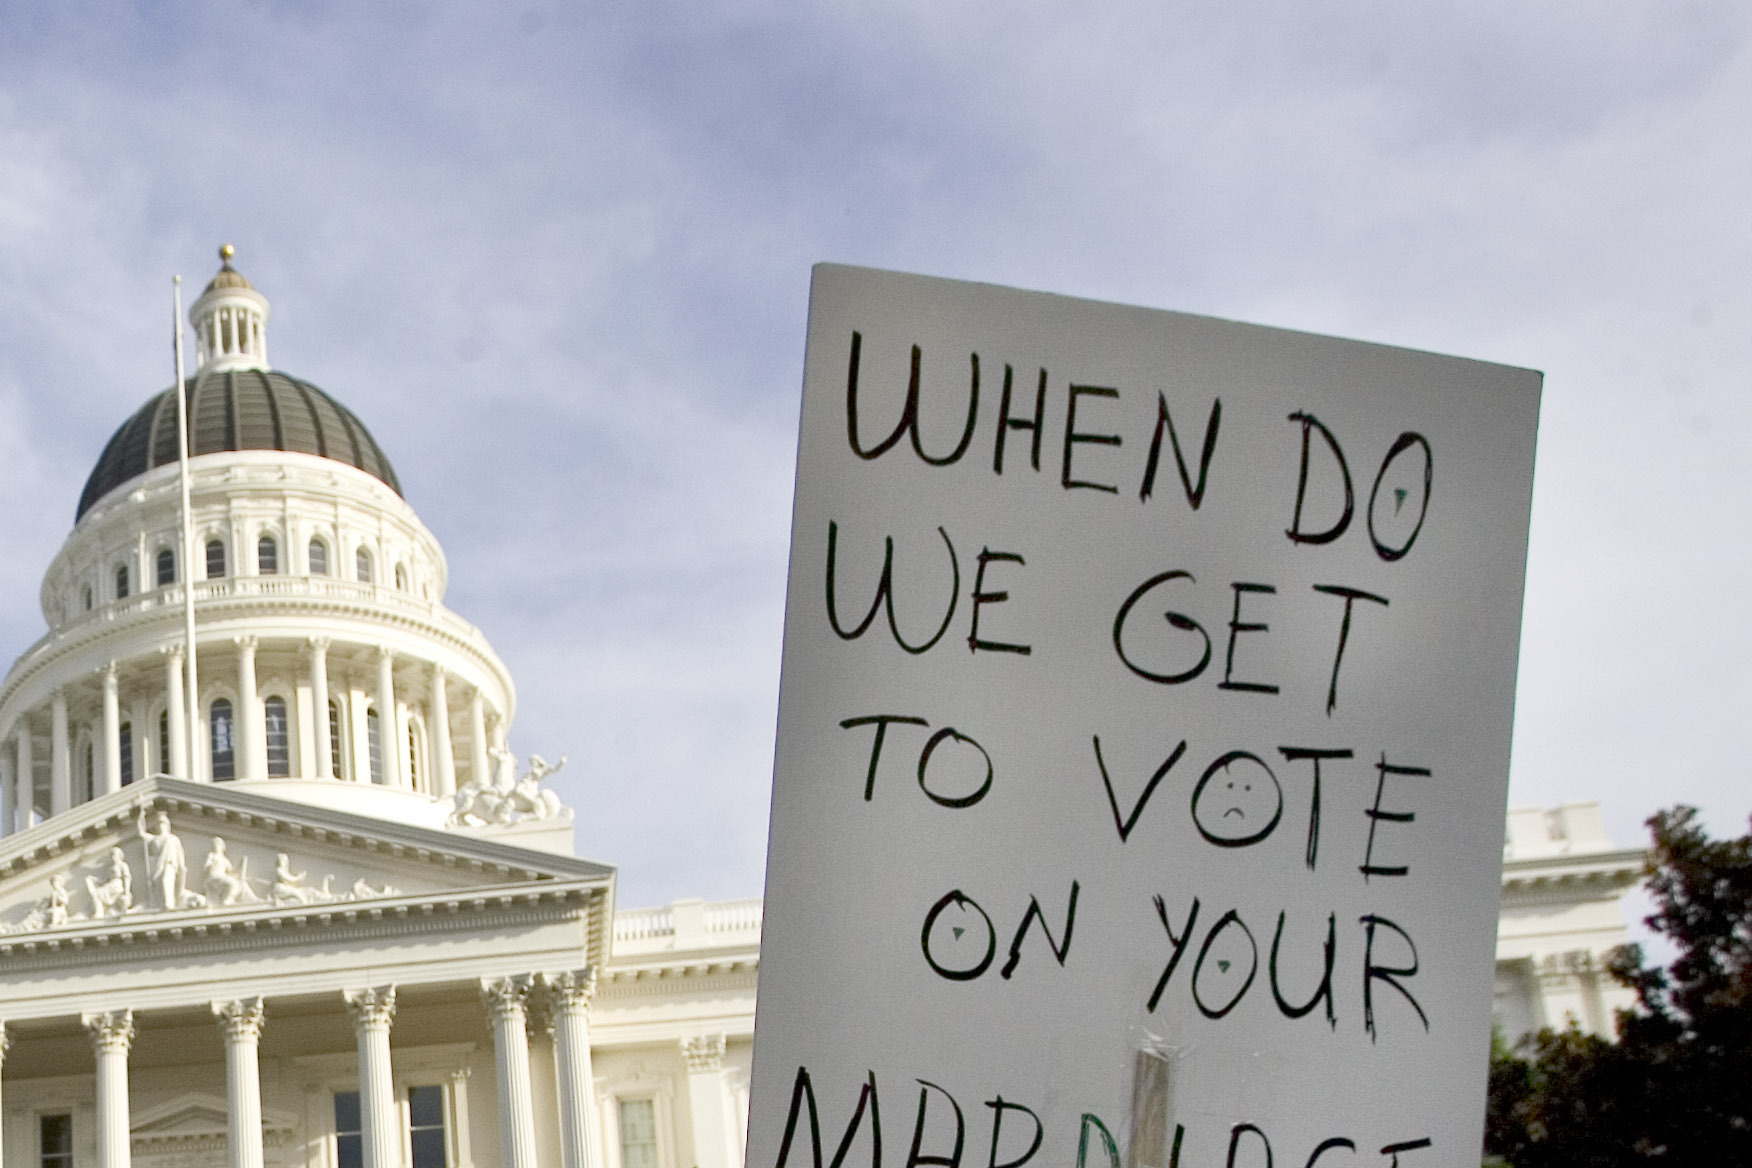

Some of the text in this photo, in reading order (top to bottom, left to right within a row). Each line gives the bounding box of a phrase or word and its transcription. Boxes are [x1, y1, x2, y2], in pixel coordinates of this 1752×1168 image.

[847, 330, 1432, 562] WHEN DO
[826, 520, 1389, 717] WE GET
[839, 715, 1431, 880] TO VOTE
[921, 880, 1428, 1043] ON YOUR
